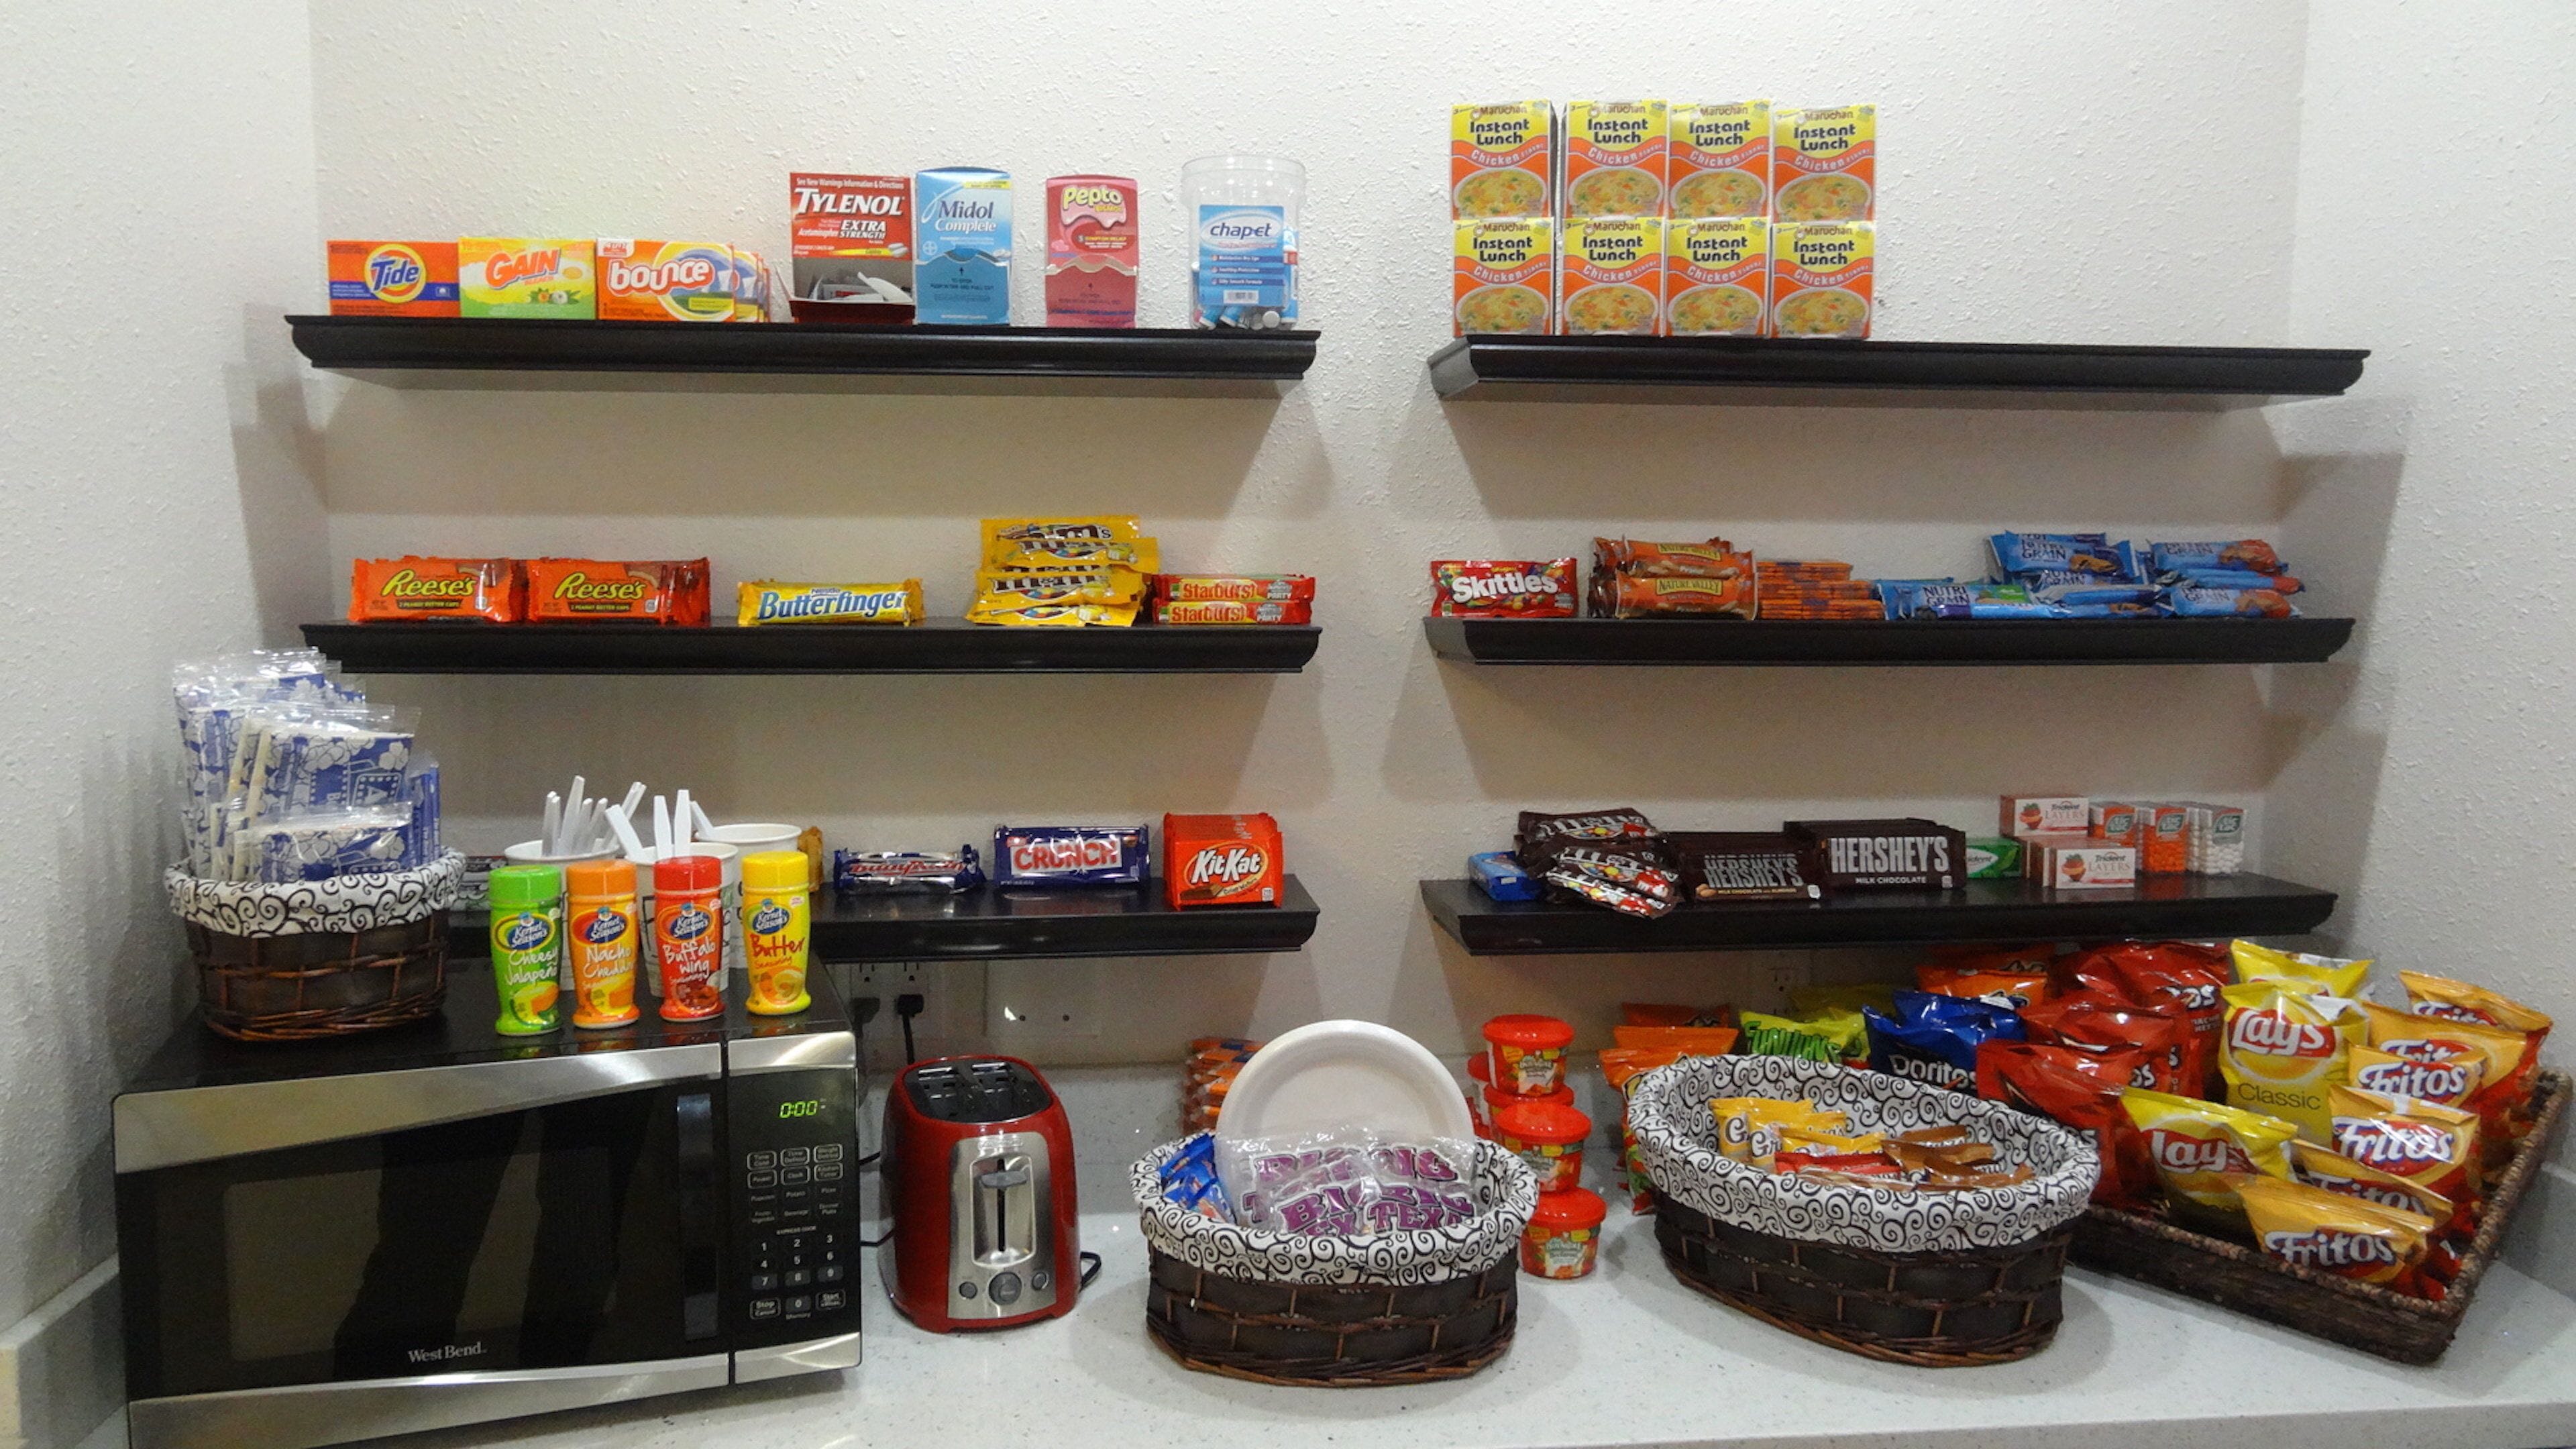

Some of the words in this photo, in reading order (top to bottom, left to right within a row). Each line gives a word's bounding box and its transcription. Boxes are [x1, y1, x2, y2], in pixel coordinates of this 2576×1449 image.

[1470, 119, 1529, 133] Instant
[1588, 118, 1648, 132] Instant
[1688, 119, 1750, 133] Instant
[1793, 123, 1856, 139] Instant
[1477, 132, 1523, 146] Lunch
[1593, 131, 1641, 144] Lunch
[1695, 133, 1743, 147] Lunch
[1800, 138, 1849, 151] Lunch
[1470, 149, 1519, 166] Chicken
[1588, 147, 1637, 165] Chicken
[1689, 150, 1739, 167] Chicken
[1793, 155, 1845, 172] Chicken
[794, 187, 903, 215] TYLENOL
[939, 201, 994, 219] Midol
[841, 219, 886, 231] EXTRA
[934, 218, 997, 235] Complete
[839, 231, 885, 239] STRENGTH
[1472, 236, 1532, 250] Instant
[1582, 236, 1644, 250] Instant
[1686, 236, 1748, 250] Instant
[1589, 249, 1636, 261] Lunch
[1793, 240, 1856, 254] Instant
[1480, 250, 1526, 262] Lunch
[1693, 250, 1741, 262] Lunch
[1800, 254, 1848, 265] Lunch
[370, 259, 420, 292] Tide
[486, 248, 561, 289] GAIN
[1473, 266, 1522, 282] Chicken
[1583, 264, 1632, 282] Chicken
[1687, 265, 1737, 283] Chicken
[608, 260, 714, 295] bounce
[1793, 269, 1844, 286] Chicken
[381, 569, 477, 596] Reese's
[553, 572, 647, 599] Reese's
[1452, 572, 1558, 603] Skittles
[1659, 579, 1690, 590] NATURE
[1691, 579, 1719, 594] VALLEY
[1923, 586, 1967, 596] NUTRI
[757, 591, 908, 620] Butterfinger
[1014, 841, 1118, 870] CRUNCH
[1831, 837, 1949, 873] HERSHEY'S
[1967, 855, 1993, 863] ident
[2095, 854, 2127, 863] Trident
[2088, 863, 2131, 871] LAYERS
[1703, 868, 1804, 888] HERSHEY'S
[1876, 876, 1927, 884] CHOCOLATE
[586, 944, 631, 963] Nacho
[663, 936, 716, 963] Buffalo
[750, 934, 804, 957] Butter
[508, 945, 558, 966] Cheesy
[2231, 1010, 2325, 1055] Lays
[2359, 1061, 2465, 1097] Fritos
[2238, 1083, 2322, 1110] Classic
[779, 1099, 818, 1119] 0:00
[2332, 1116, 2455, 1162] Fritos
[1367, 1200, 1464, 1233] TEXA
[761, 1242, 767, 1251] 1
[794, 1238, 801, 1248] 2
[826, 1234, 833, 1244] 3
[2265, 1232, 2396, 1267] Fritos
[761, 1260, 767, 1269] 4
[761, 1276, 768, 1286] 7
[409, 1348, 442, 1363] West
[445, 1341, 482, 1358] Bend
